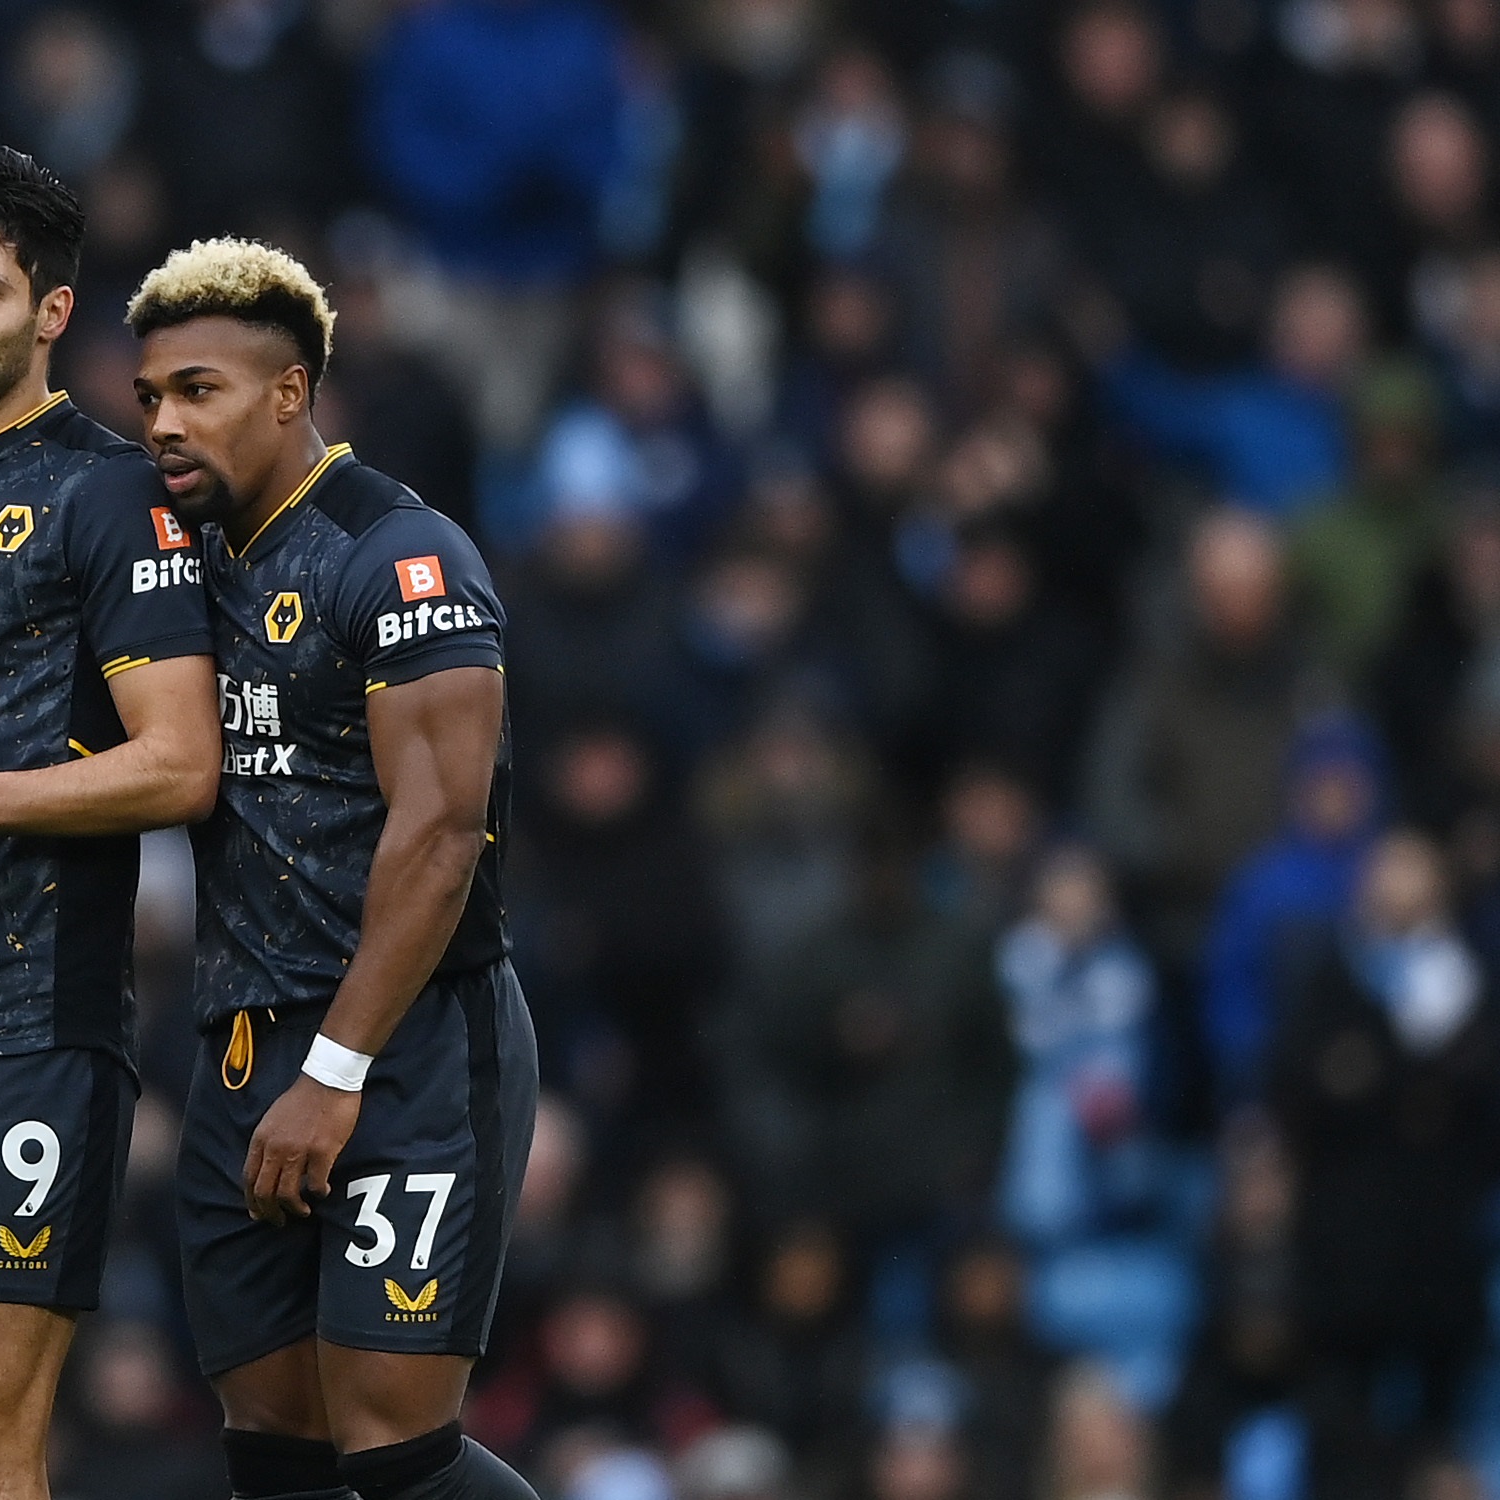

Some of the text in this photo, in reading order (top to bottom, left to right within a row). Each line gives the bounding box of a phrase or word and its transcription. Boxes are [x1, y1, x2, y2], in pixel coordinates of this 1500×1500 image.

[222, 744, 297, 776] BetX
[2, 1120, 60, 1217] 9
[345, 1173, 456, 1270] 37
[384, 1312, 438, 1322] CASTORE
